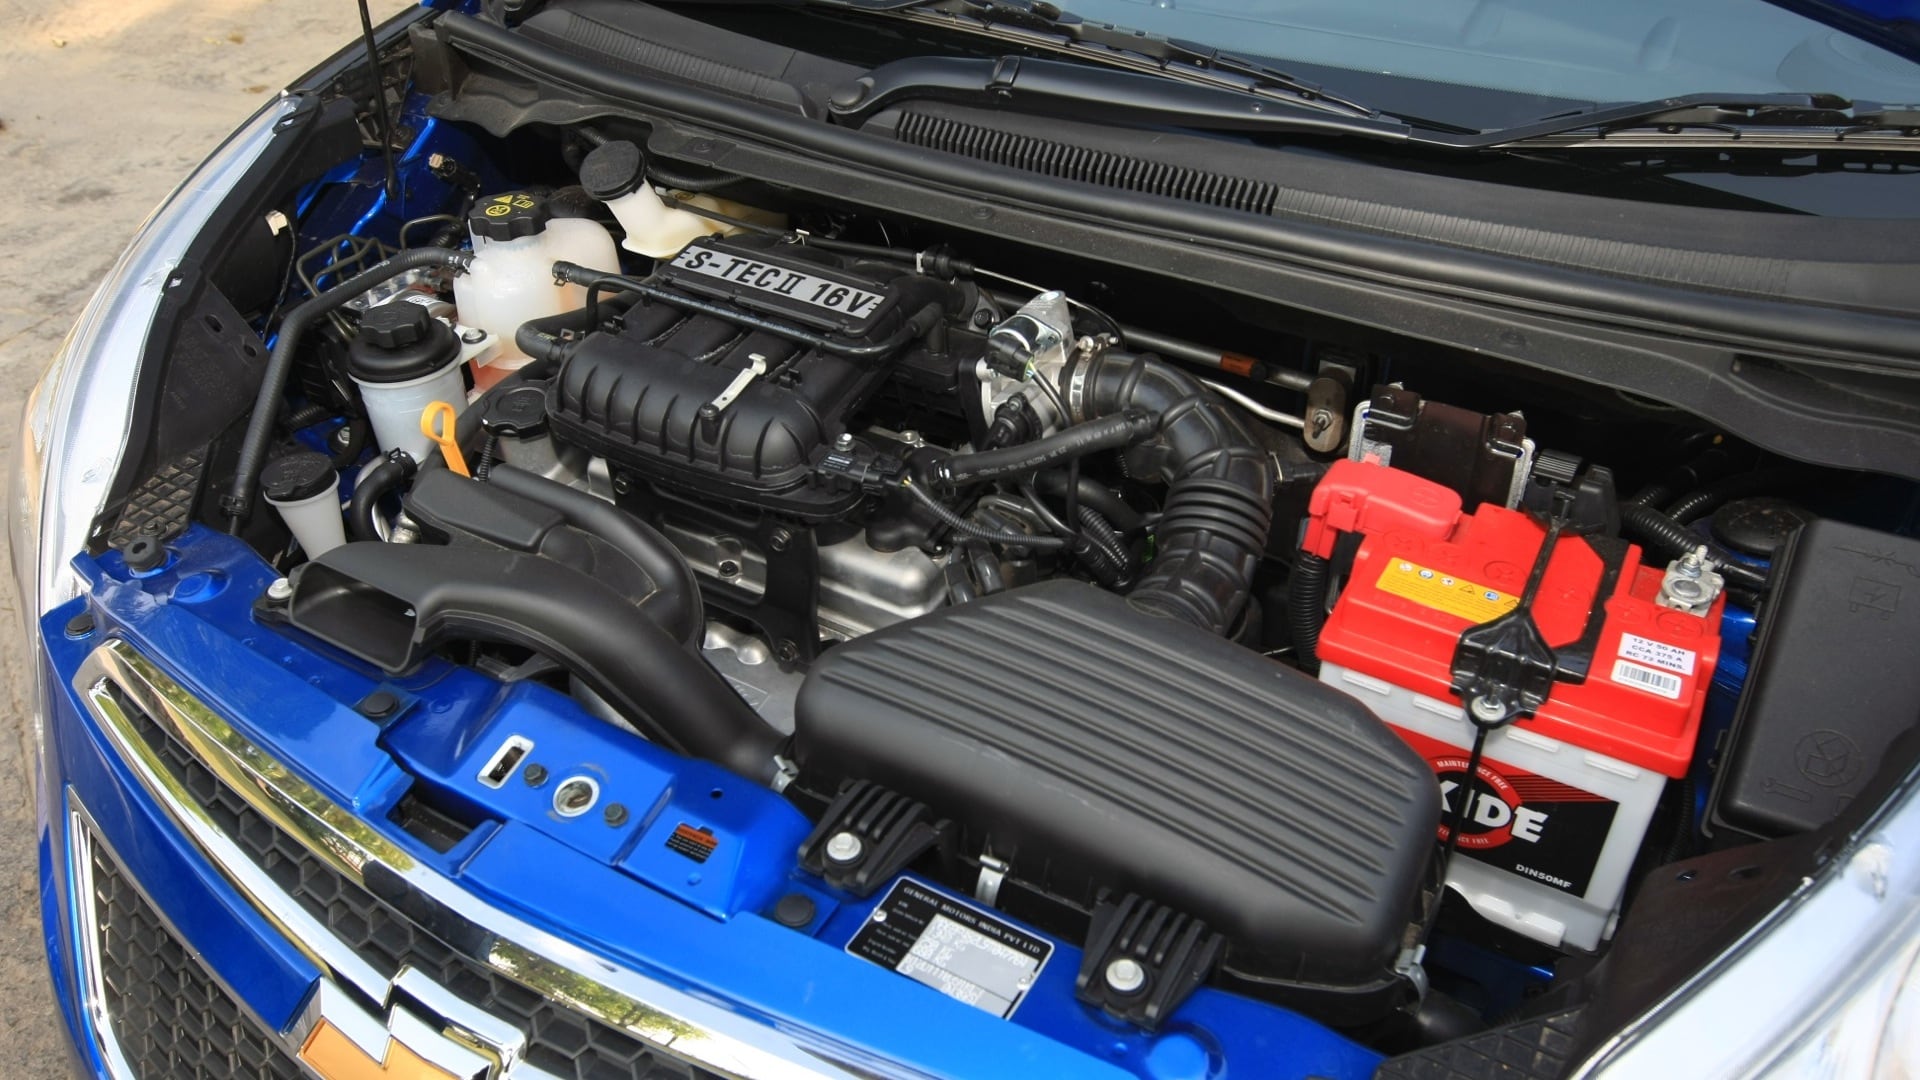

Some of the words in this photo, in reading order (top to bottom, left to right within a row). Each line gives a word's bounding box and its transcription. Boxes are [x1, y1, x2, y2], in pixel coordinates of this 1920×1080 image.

[810, 283, 875, 313] 16V
[1631, 645, 1652, 654] CCA
[1671, 648, 1685, 656] AH
[1490, 775, 1508, 790] FREE
[1515, 864, 1572, 888] DIN50MF
[904, 887, 939, 908] GENERAL
[941, 904, 976, 925] MOTORS
[978, 921, 1002, 937] INDIA
[1003, 932, 1021, 945] PVT
[1022, 941, 1041, 954] LTD
